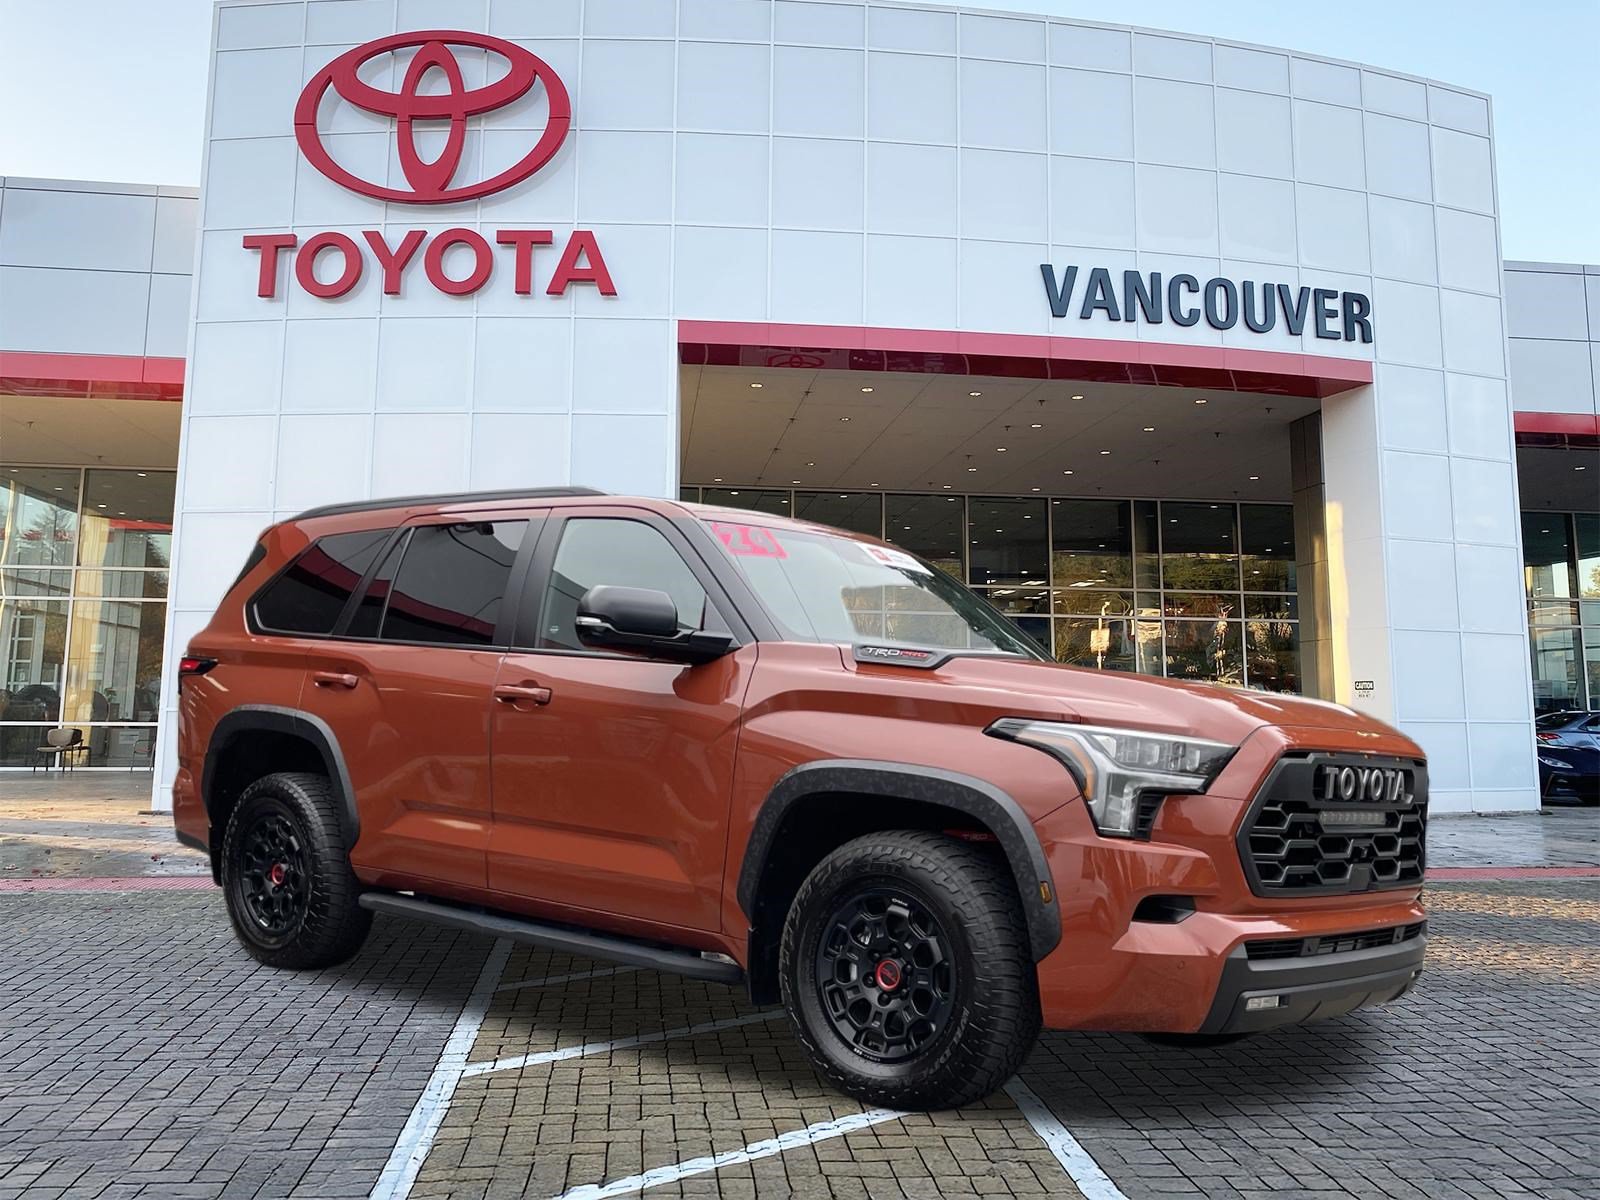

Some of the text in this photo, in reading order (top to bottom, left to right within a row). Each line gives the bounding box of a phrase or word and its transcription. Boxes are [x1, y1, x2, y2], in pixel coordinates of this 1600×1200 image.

[243, 227, 618, 299] TOYOTA
[1040, 264, 1373, 344] VANCOUVER
[1325, 766, 1406, 801] TOYOTA
